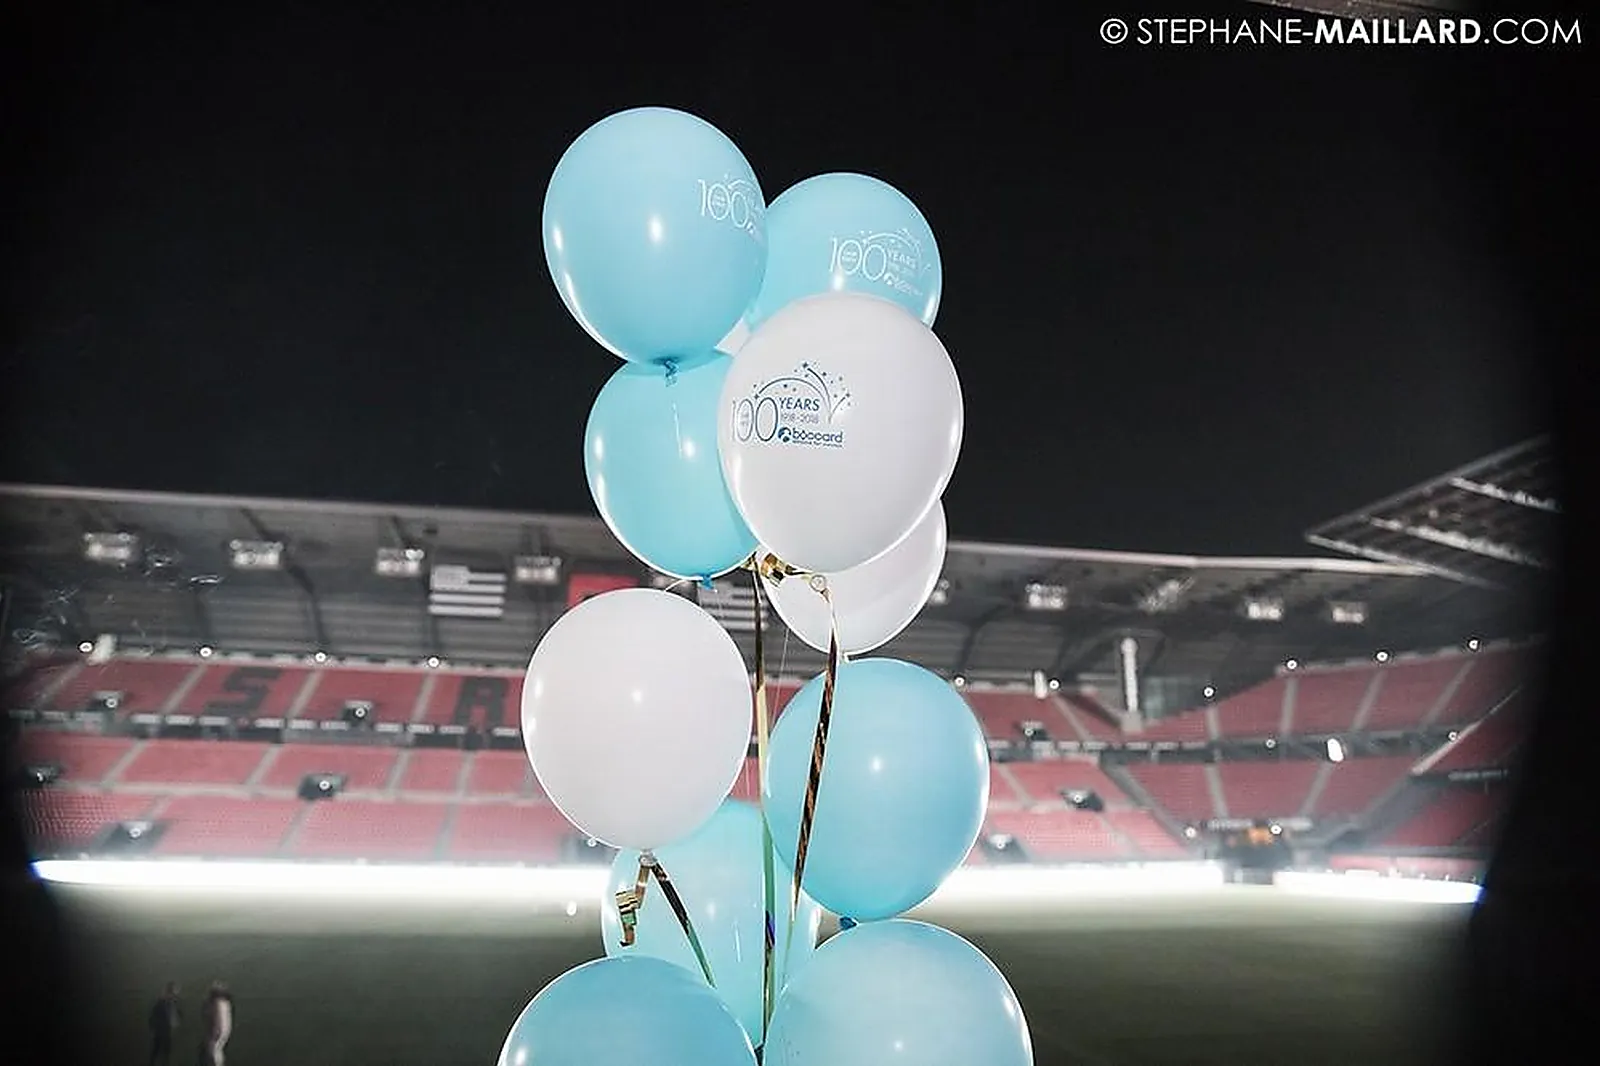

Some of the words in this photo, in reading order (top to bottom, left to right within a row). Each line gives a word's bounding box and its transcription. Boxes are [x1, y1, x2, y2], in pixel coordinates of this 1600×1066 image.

[698, 178, 750, 229] 100
[830, 236, 887, 281] 100
[731, 396, 778, 442] 100
[779, 397, 820, 412] YEARS
[792, 427, 843, 443] boccard
